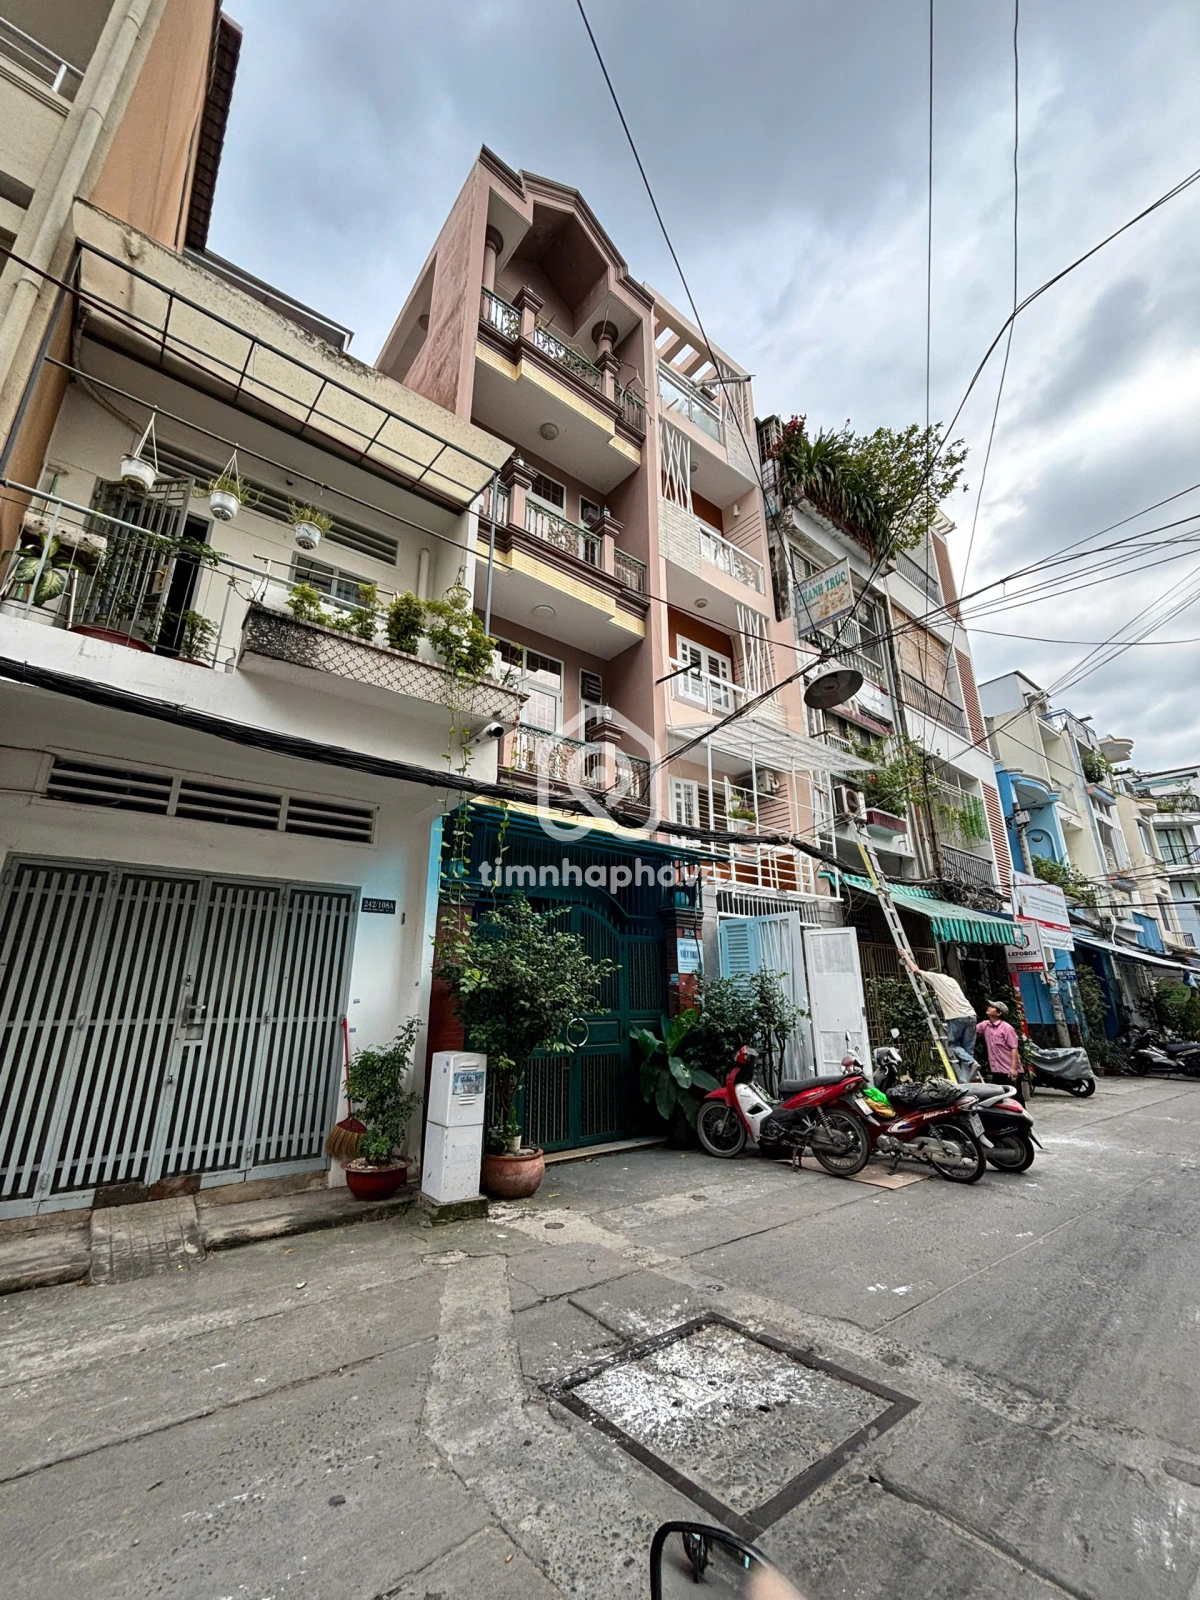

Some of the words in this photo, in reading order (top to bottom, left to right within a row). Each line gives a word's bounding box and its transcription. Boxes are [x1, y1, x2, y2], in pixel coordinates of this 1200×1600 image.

[798, 583, 824, 605] THANH
[825, 571, 846, 592] TRÚC
[363, 900, 394, 910] 242/108A
